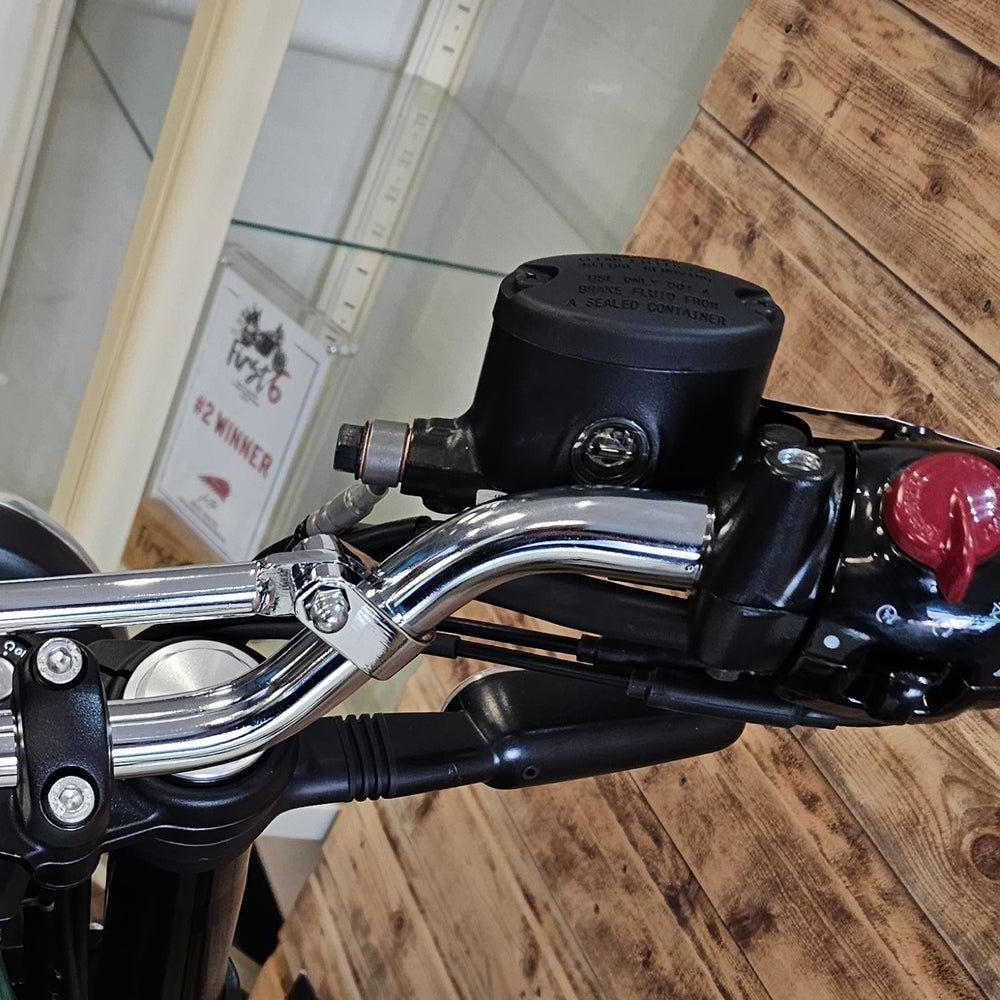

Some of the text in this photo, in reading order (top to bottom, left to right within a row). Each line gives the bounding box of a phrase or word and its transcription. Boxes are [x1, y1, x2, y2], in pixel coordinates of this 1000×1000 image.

[587, 274, 613, 283] USE
[624, 276, 658, 285] ONLY
[578, 285, 719, 310] BRAKE FLUID FROM
[566, 298, 727, 327] A SEALED CONTAINER
[193, 394, 214, 427] #2
[214, 413, 274, 480] WINNER
